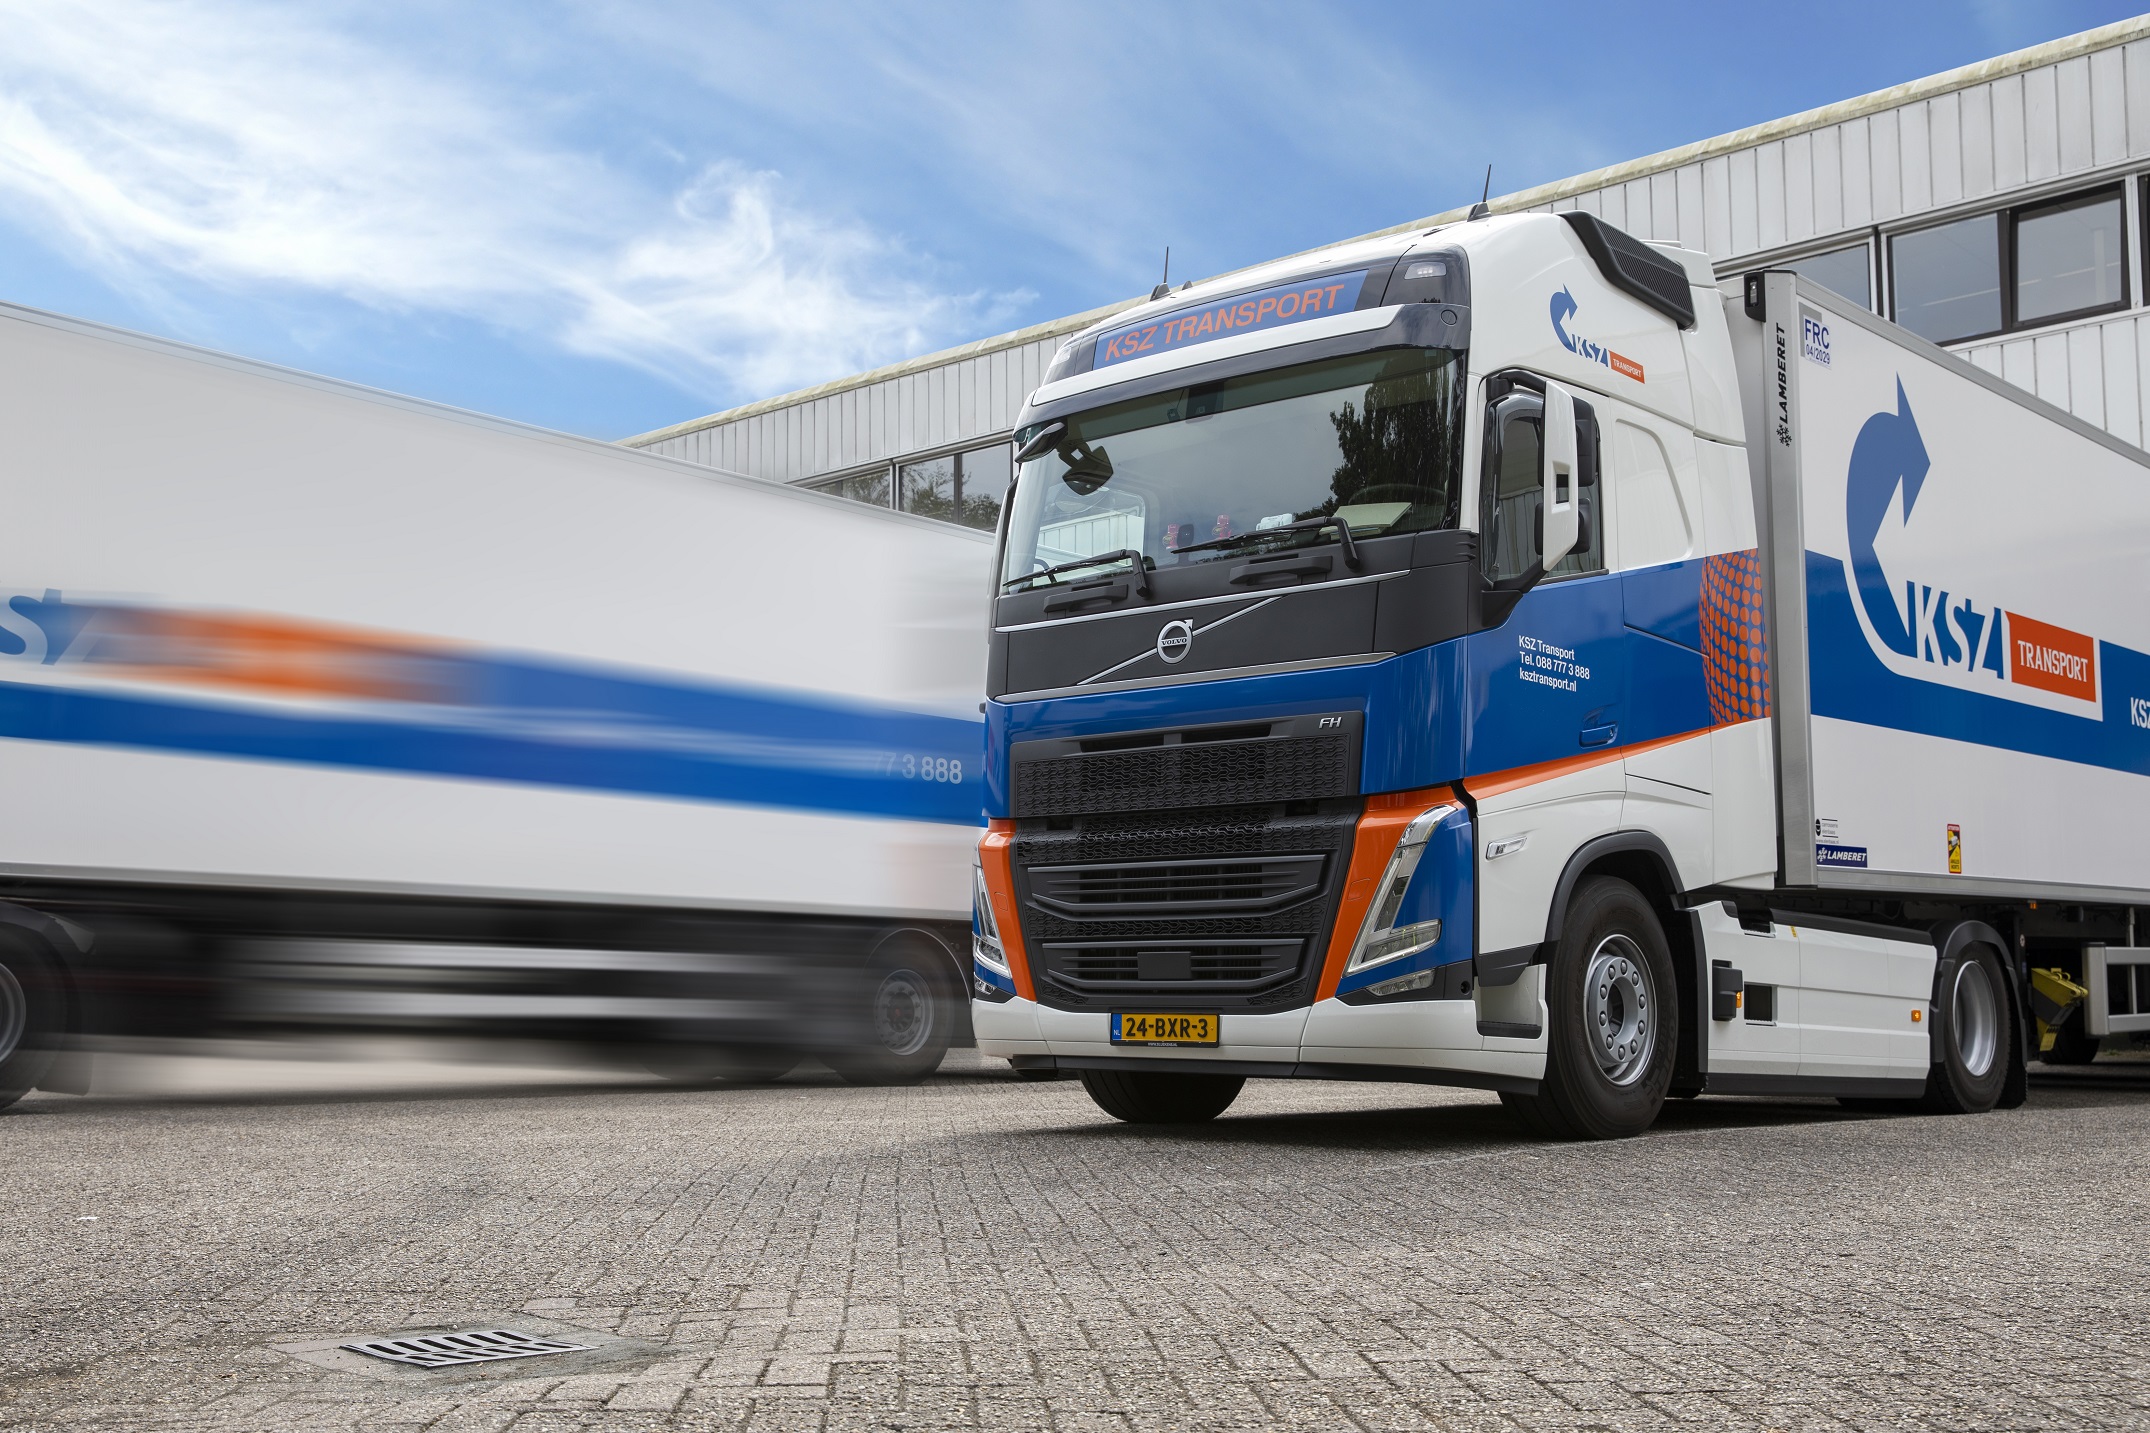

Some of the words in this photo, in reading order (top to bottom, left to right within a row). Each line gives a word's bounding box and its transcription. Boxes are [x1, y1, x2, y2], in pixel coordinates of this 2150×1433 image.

[1105, 328, 1158, 362] KSZ
[1163, 284, 1345, 344] TRANSPORT
[1805, 319, 1830, 349] FRC
[1574, 335, 1608, 367] KSZ
[1613, 358, 1642, 377] TRANSPORT
[1806, 344, 1831, 365] 04/2029
[1776, 322, 1788, 424] LAMBERET
[1161, 638, 1188, 646] VOLVO
[1911, 582, 2003, 680] KSZ
[2017, 639, 2089, 683] TRANSPORT
[1518, 635, 1537, 651] KSZ
[1537, 640, 1575, 660] Transport
[1520, 651, 1535, 666] Tel.
[1536, 655, 1552, 670] 088
[1553, 659, 1567, 674] 777
[1568, 664, 1574, 676] 3
[1574, 665, 1590, 680] 888
[1519, 667, 1577, 692] ksztransport.nl
[1318, 717, 1342, 729] FH
[901, 753, 916, 779] 3
[921, 756, 962, 784] 888
[1827, 850, 1867, 862] LAMBERET
[1125, 1017, 1208, 1038] 24-BXR-3
